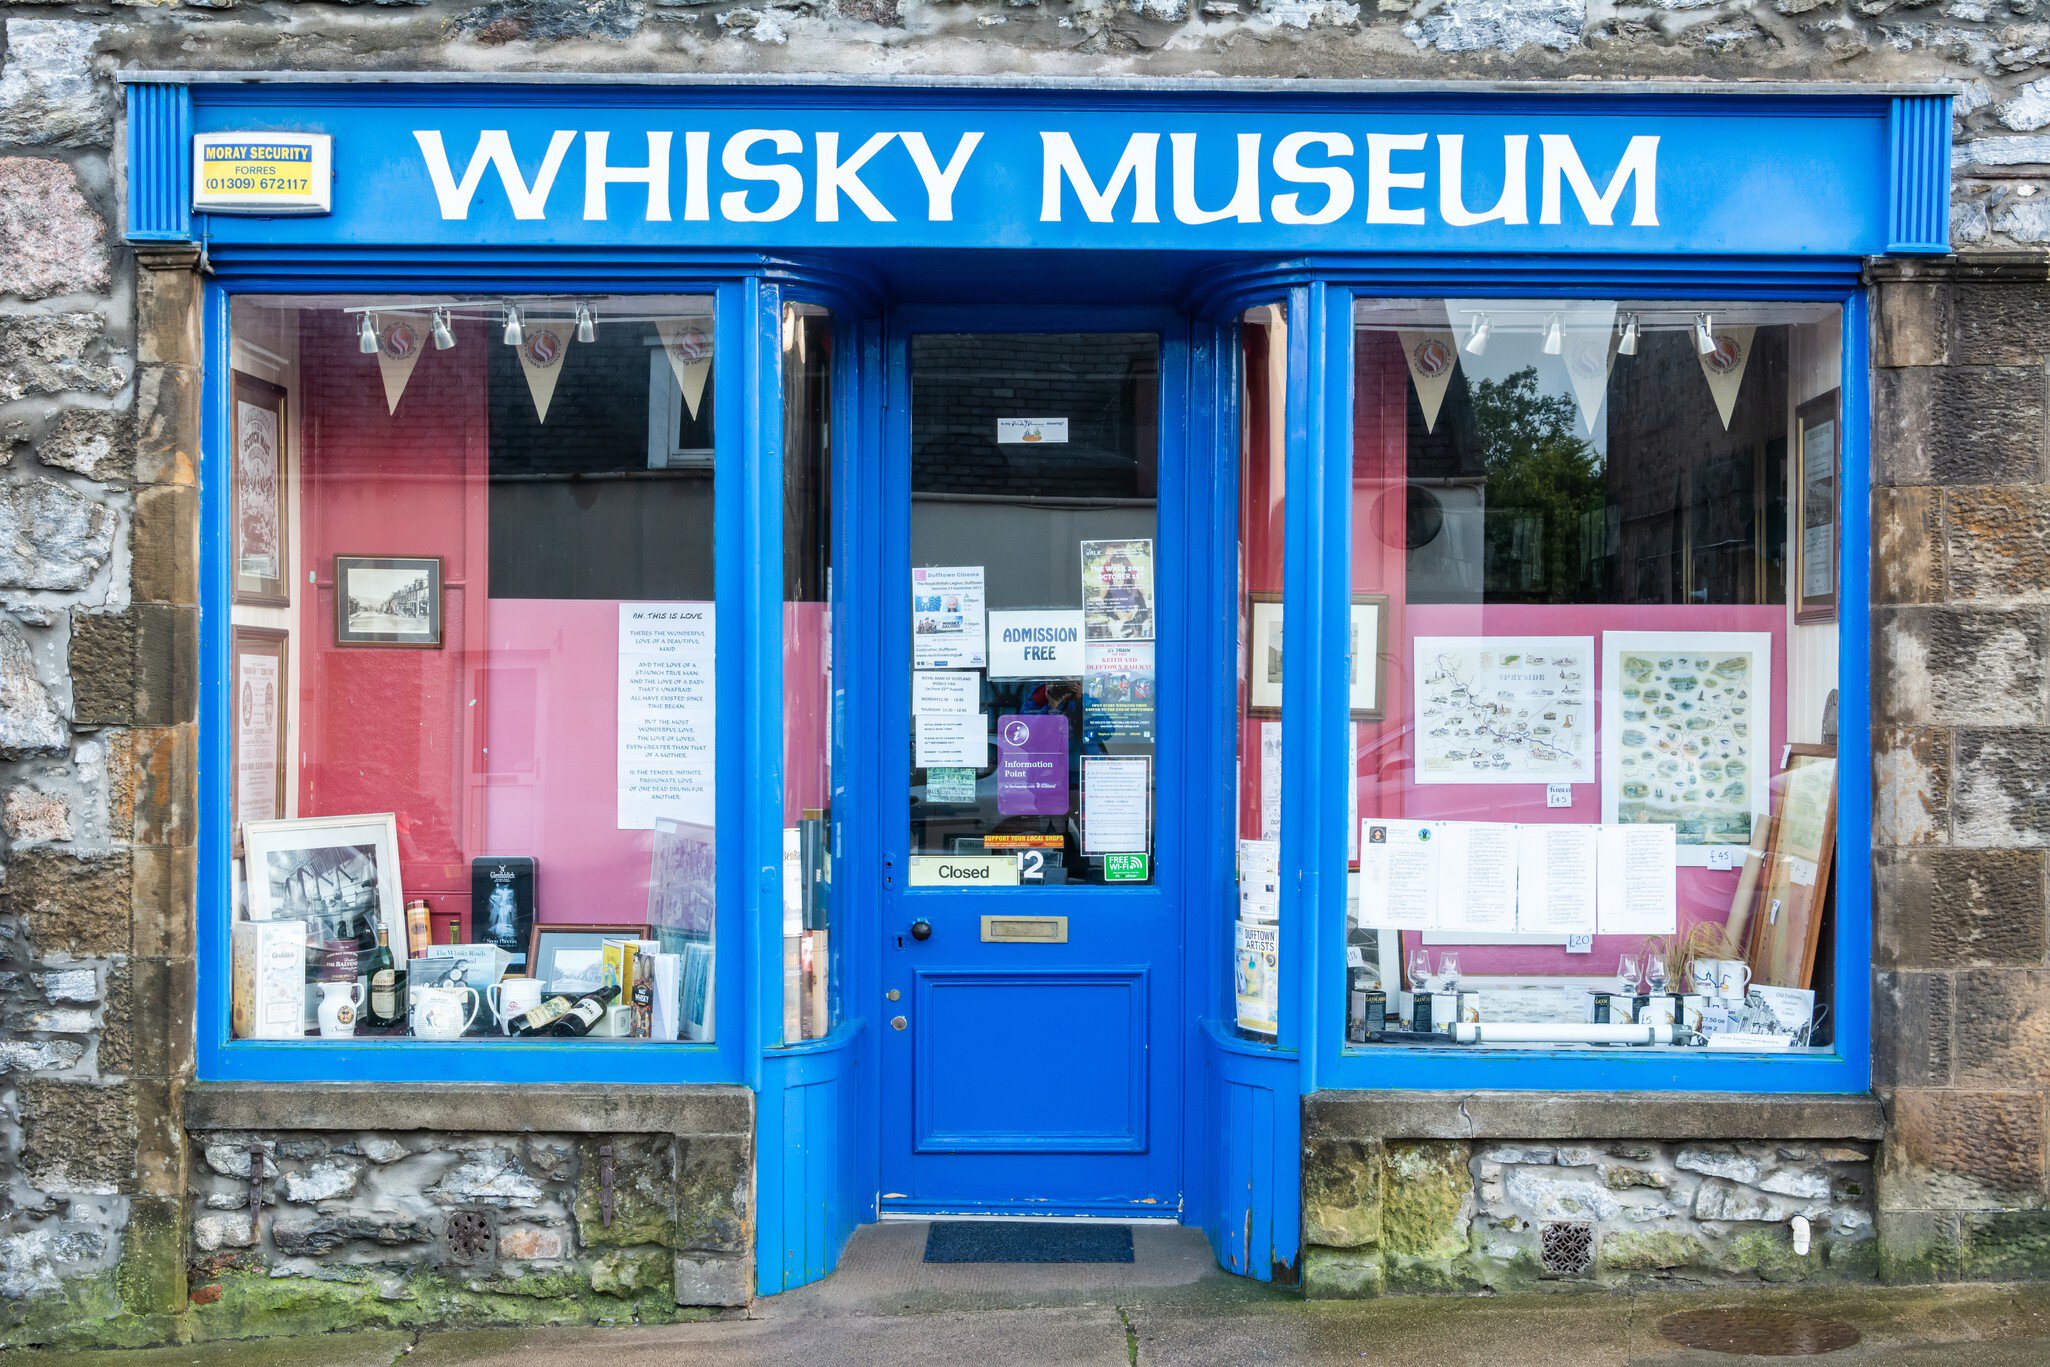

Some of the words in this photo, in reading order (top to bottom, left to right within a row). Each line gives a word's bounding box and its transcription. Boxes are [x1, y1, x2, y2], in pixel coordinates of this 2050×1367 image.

[206, 146, 247, 160] MORAY
[250, 146, 308, 160] SECURITY
[235, 166, 276, 175] FORRES
[206, 178, 255, 190] (01309)
[260, 178, 308, 190] 672117
[412, 128, 985, 223] WHISKY
[1039, 131, 1661, 227] MUSEUM
[1003, 628, 1077, 642] ADMISSION
[1024, 646, 1056, 660] FREE
[1710, 850, 1729, 862] £45
[938, 865, 990, 878] Closed
[1245, 928, 1275, 941] DUFFTOWN
[1569, 934, 1589, 947] £20
[1641, 1014, 1652, 1024] £5
